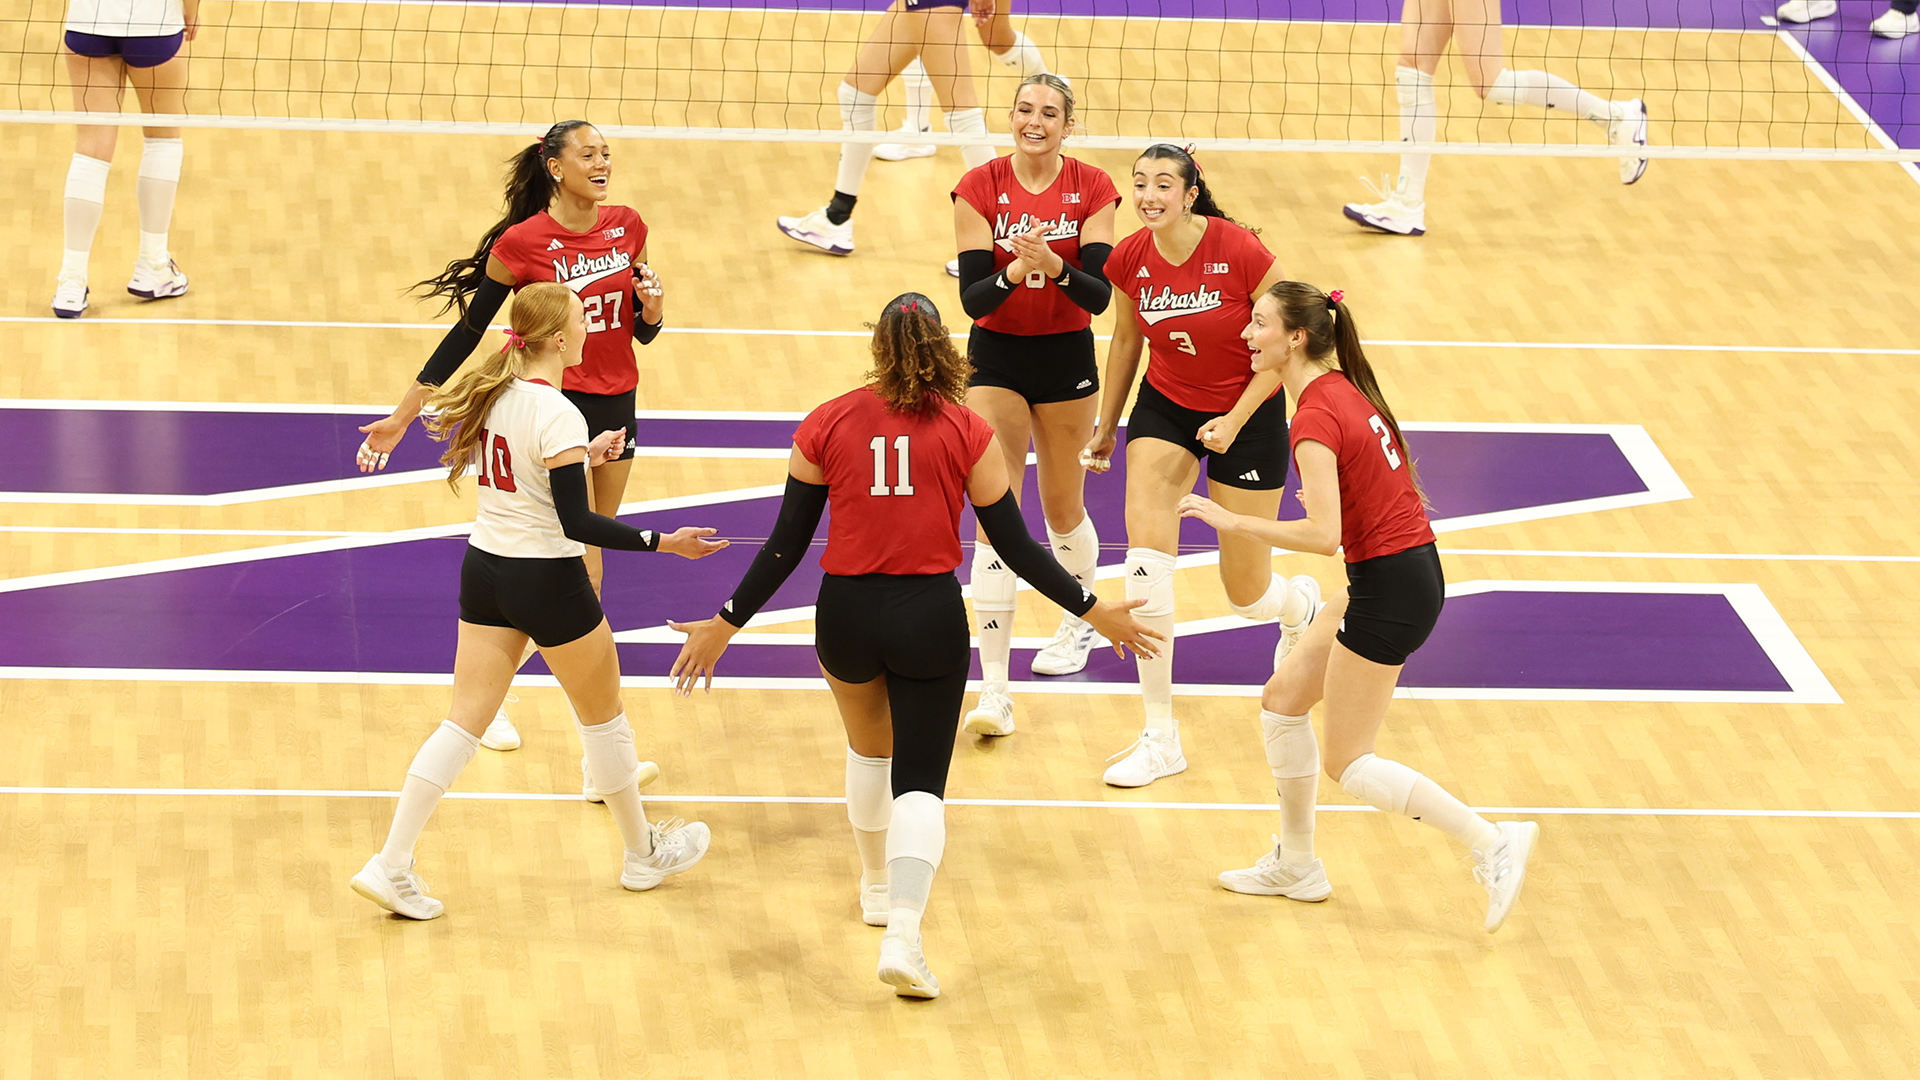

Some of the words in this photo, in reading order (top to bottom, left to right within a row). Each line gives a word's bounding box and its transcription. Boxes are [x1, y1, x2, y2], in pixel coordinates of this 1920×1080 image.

[552, 247, 630, 284] Nebraska
[584, 291, 623, 333] 27
[1138, 284, 1221, 311] Nebraska
[1168, 331, 1197, 356] 3
[478, 428, 517, 493] 10
[1368, 414, 1401, 471] 2
[869, 435, 915, 496] 11
